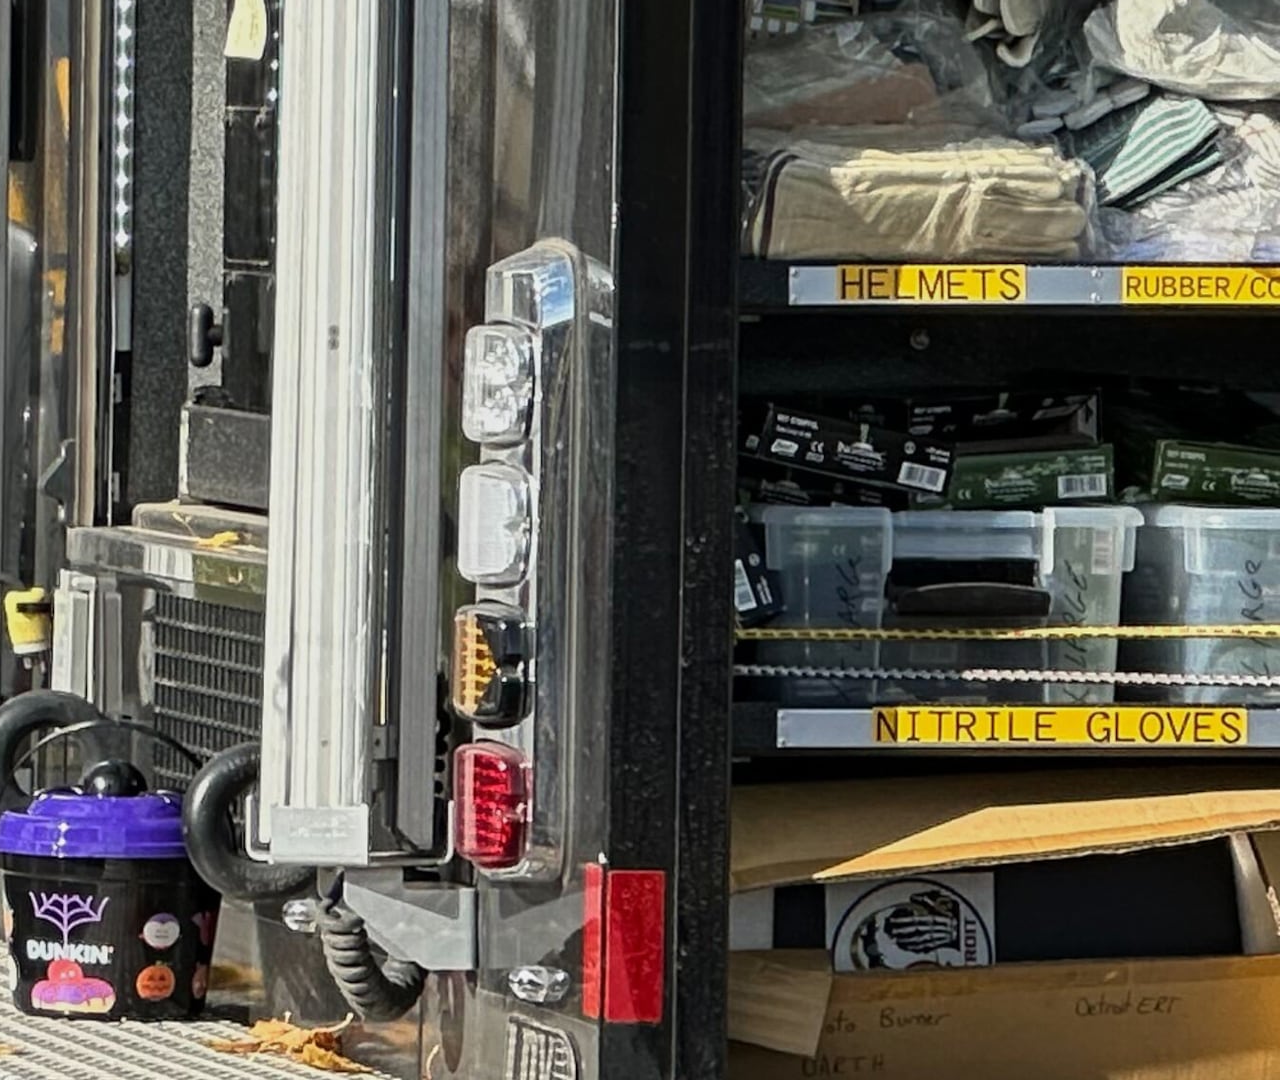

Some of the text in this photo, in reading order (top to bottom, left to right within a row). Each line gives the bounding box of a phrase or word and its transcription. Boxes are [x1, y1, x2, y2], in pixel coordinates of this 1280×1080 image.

[841, 268, 1021, 301] HELMETS
[875, 710, 1243, 744] NITRILE GLOVES
[964, 918, 977, 967] ROIT
[823, 1009, 857, 1035] oto
[1136, 995, 1183, 1016] ERT
